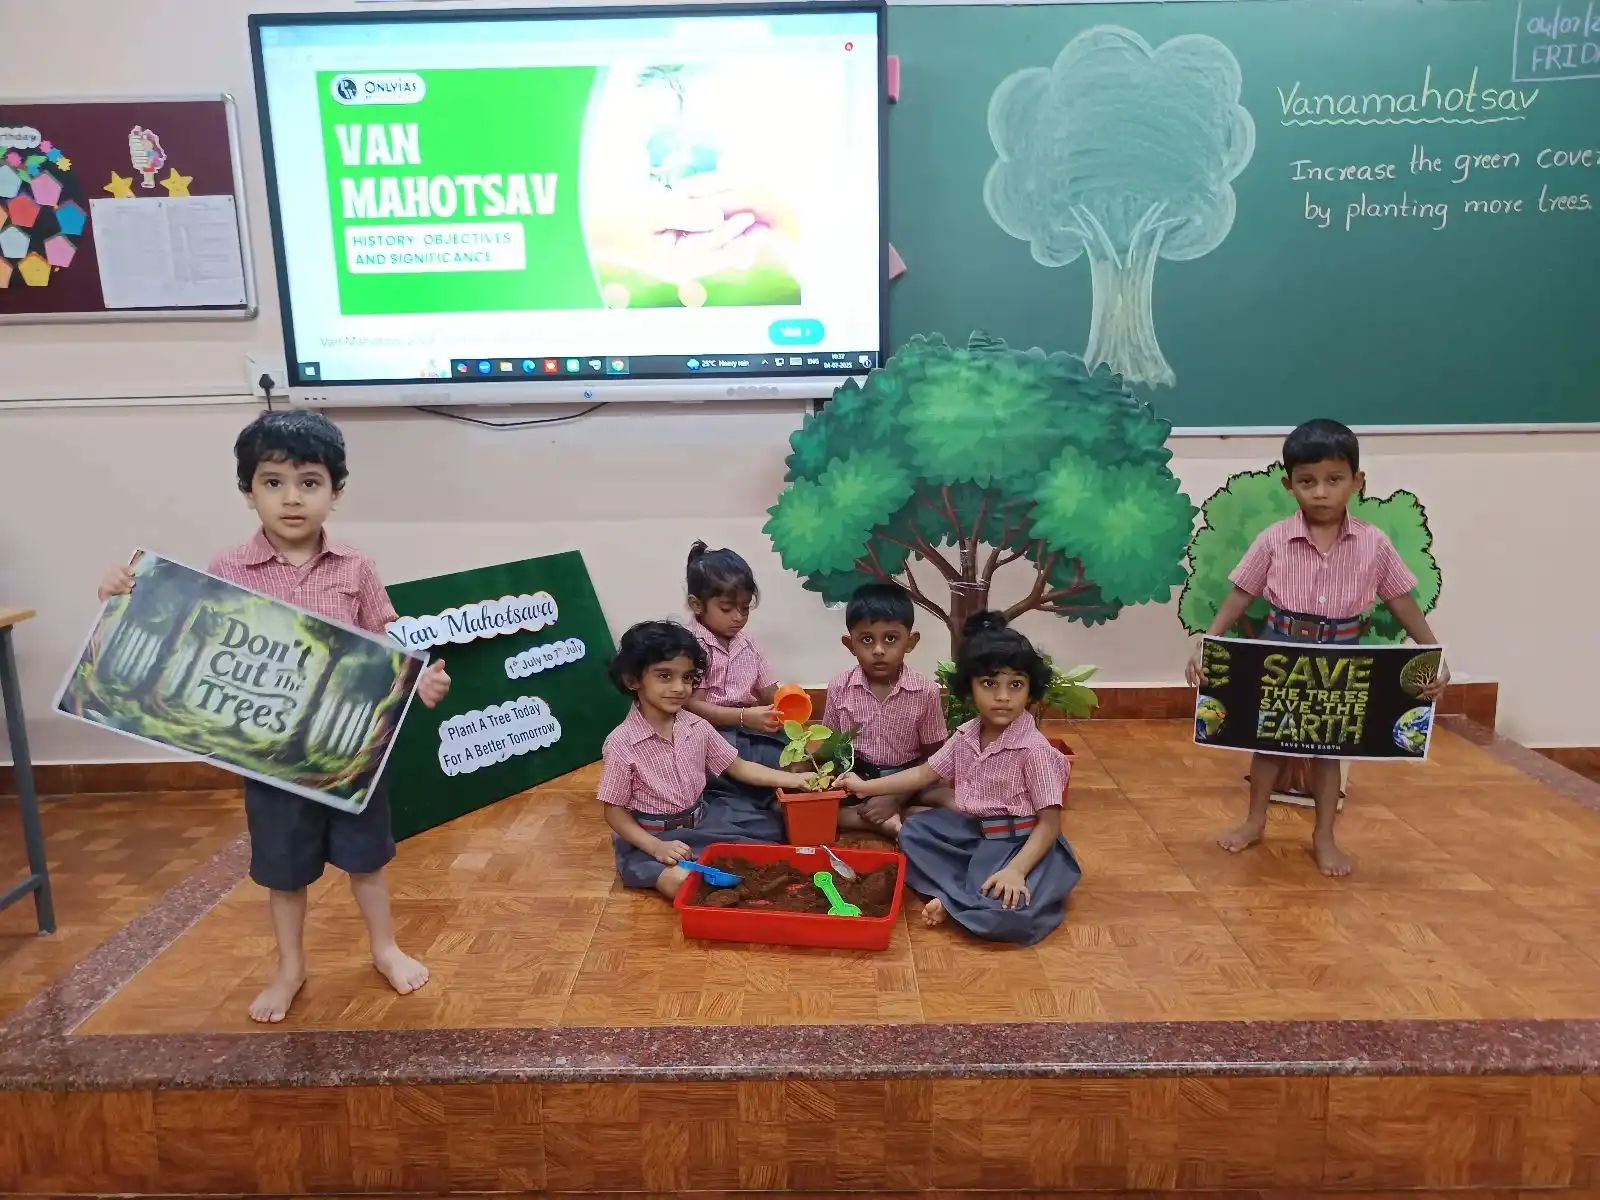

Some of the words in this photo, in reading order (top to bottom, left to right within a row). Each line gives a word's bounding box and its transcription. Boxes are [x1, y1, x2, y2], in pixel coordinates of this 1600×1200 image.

[1532, 42, 1600, 73] FRID
[1276, 64, 1540, 116] Vanamahotsav
[334, 122, 421, 165] VAN
[1289, 159, 1396, 182] Increase
[1409, 144, 1442, 175] the
[1449, 152, 1519, 184] green
[340, 173, 558, 219] MAHOTSAV
[1304, 191, 1331, 229] by
[1346, 192, 1448, 231] planting
[1464, 197, 1523, 214] more
[356, 253, 386, 265] AND
[390, 251, 491, 265] SIGNIFICANCE
[423, 232, 512, 246] OBJECTIVES
[218, 617, 312, 669] Don't
[388, 625, 439, 648] Van
[440, 601, 554, 638] Mahotsava
[209, 650, 270, 688] Cut
[522, 655, 542, 670] July
[542, 653, 554, 662] to
[565, 643, 582, 656] July
[1261, 653, 1374, 690] SAVE
[196, 678, 287, 734] Trees
[1261, 686, 1300, 700] THE
[1306, 689, 1369, 704] TREES
[447, 721, 478, 741] Plant
[478, 718, 488, 731] A
[487, 712, 512, 728] Tree
[511, 702, 542, 721] Today
[1256, 709, 1364, 745] EARTH
[443, 754, 463, 768] For
[465, 747, 474, 761] A
[474, 738, 507, 758] Better
[506, 723, 556, 744] Tomorrow
